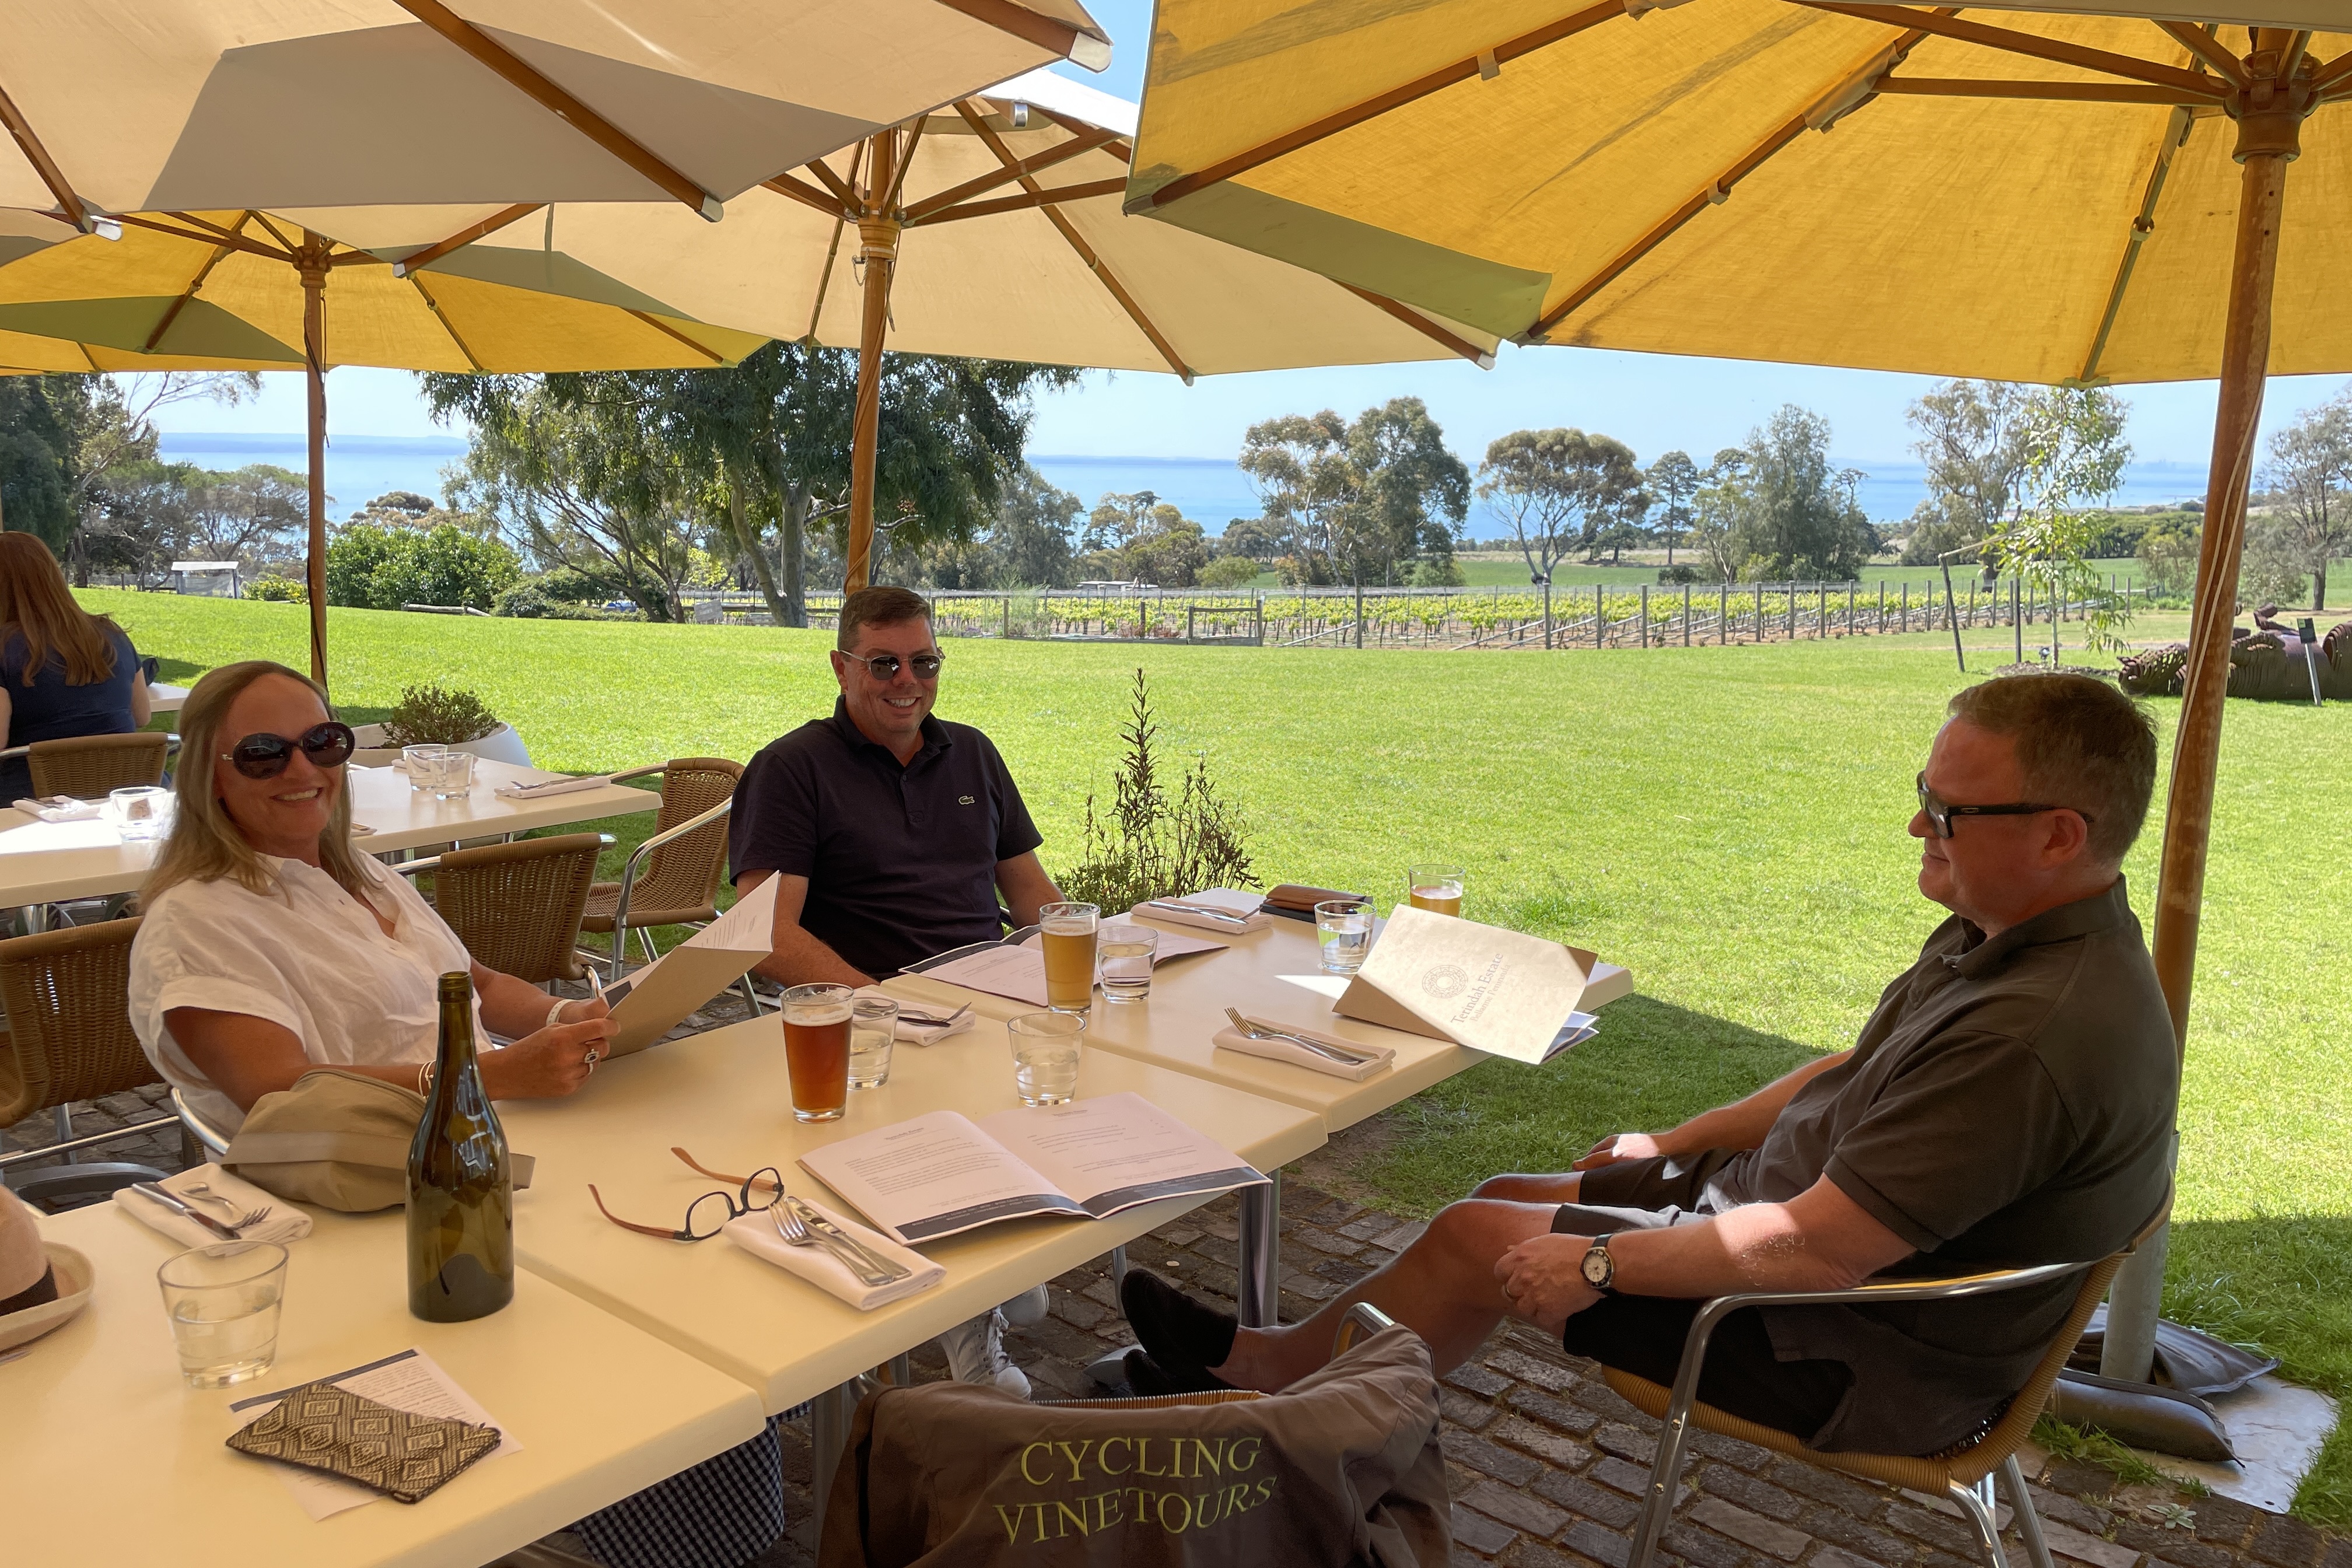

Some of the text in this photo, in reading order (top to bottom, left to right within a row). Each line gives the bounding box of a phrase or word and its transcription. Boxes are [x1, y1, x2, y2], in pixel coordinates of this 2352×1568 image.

[1450, 953, 1503, 1023] Terindah Estate
[1021, 1437, 1261, 1486] CYCLING
